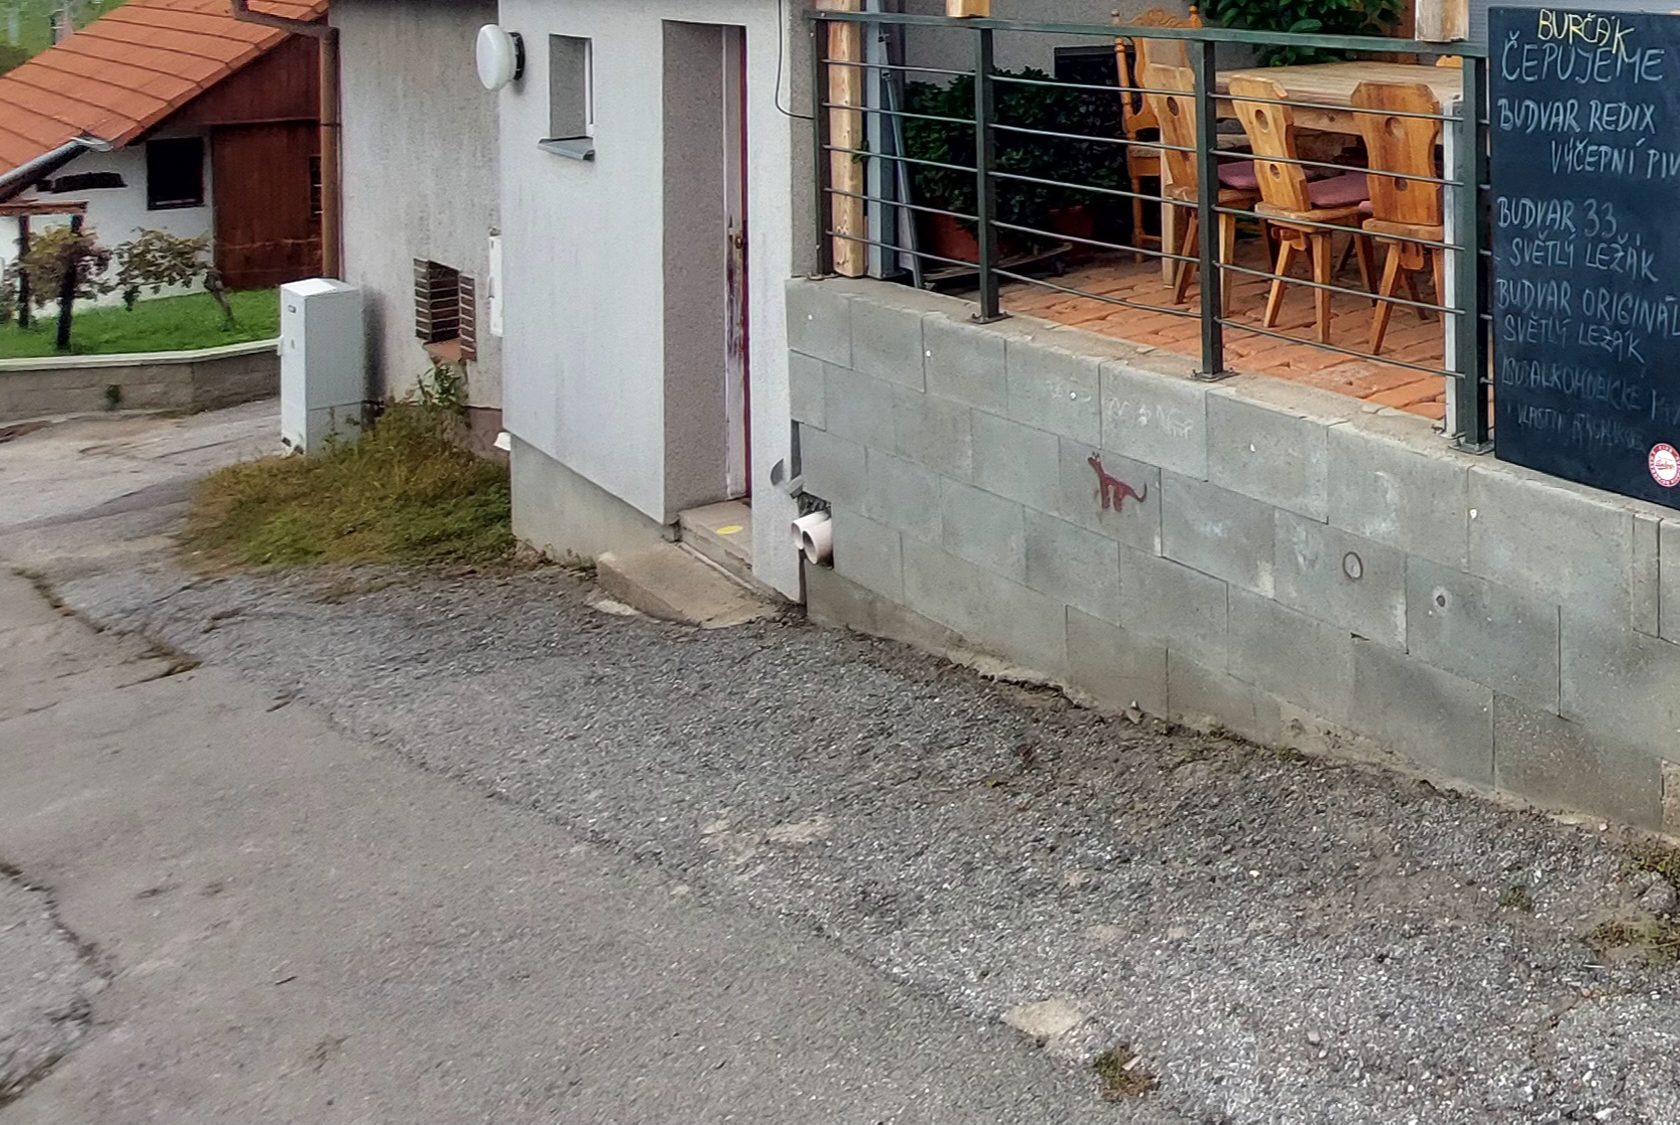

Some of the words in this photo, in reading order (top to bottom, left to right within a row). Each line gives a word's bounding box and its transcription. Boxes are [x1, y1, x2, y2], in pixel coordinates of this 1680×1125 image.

[1537, 8, 1635, 63] BURČÁK
[1501, 29, 1666, 85] ČEPUJEME
[1497, 97, 1581, 135] BUDVAR
[1588, 98, 1656, 135] REDIX
[1551, 136, 1646, 175] VÝČEPNÍ
[1497, 196, 1577, 233] BUDVAR
[1583, 198, 1618, 237] 33
[1508, 229, 1577, 269] SVĚTLÝ
[1585, 232, 1660, 283] LEŽÁK
[1496, 278, 1572, 316] BUDVAR
[1503, 311, 1573, 349] SVĚTLÝ
